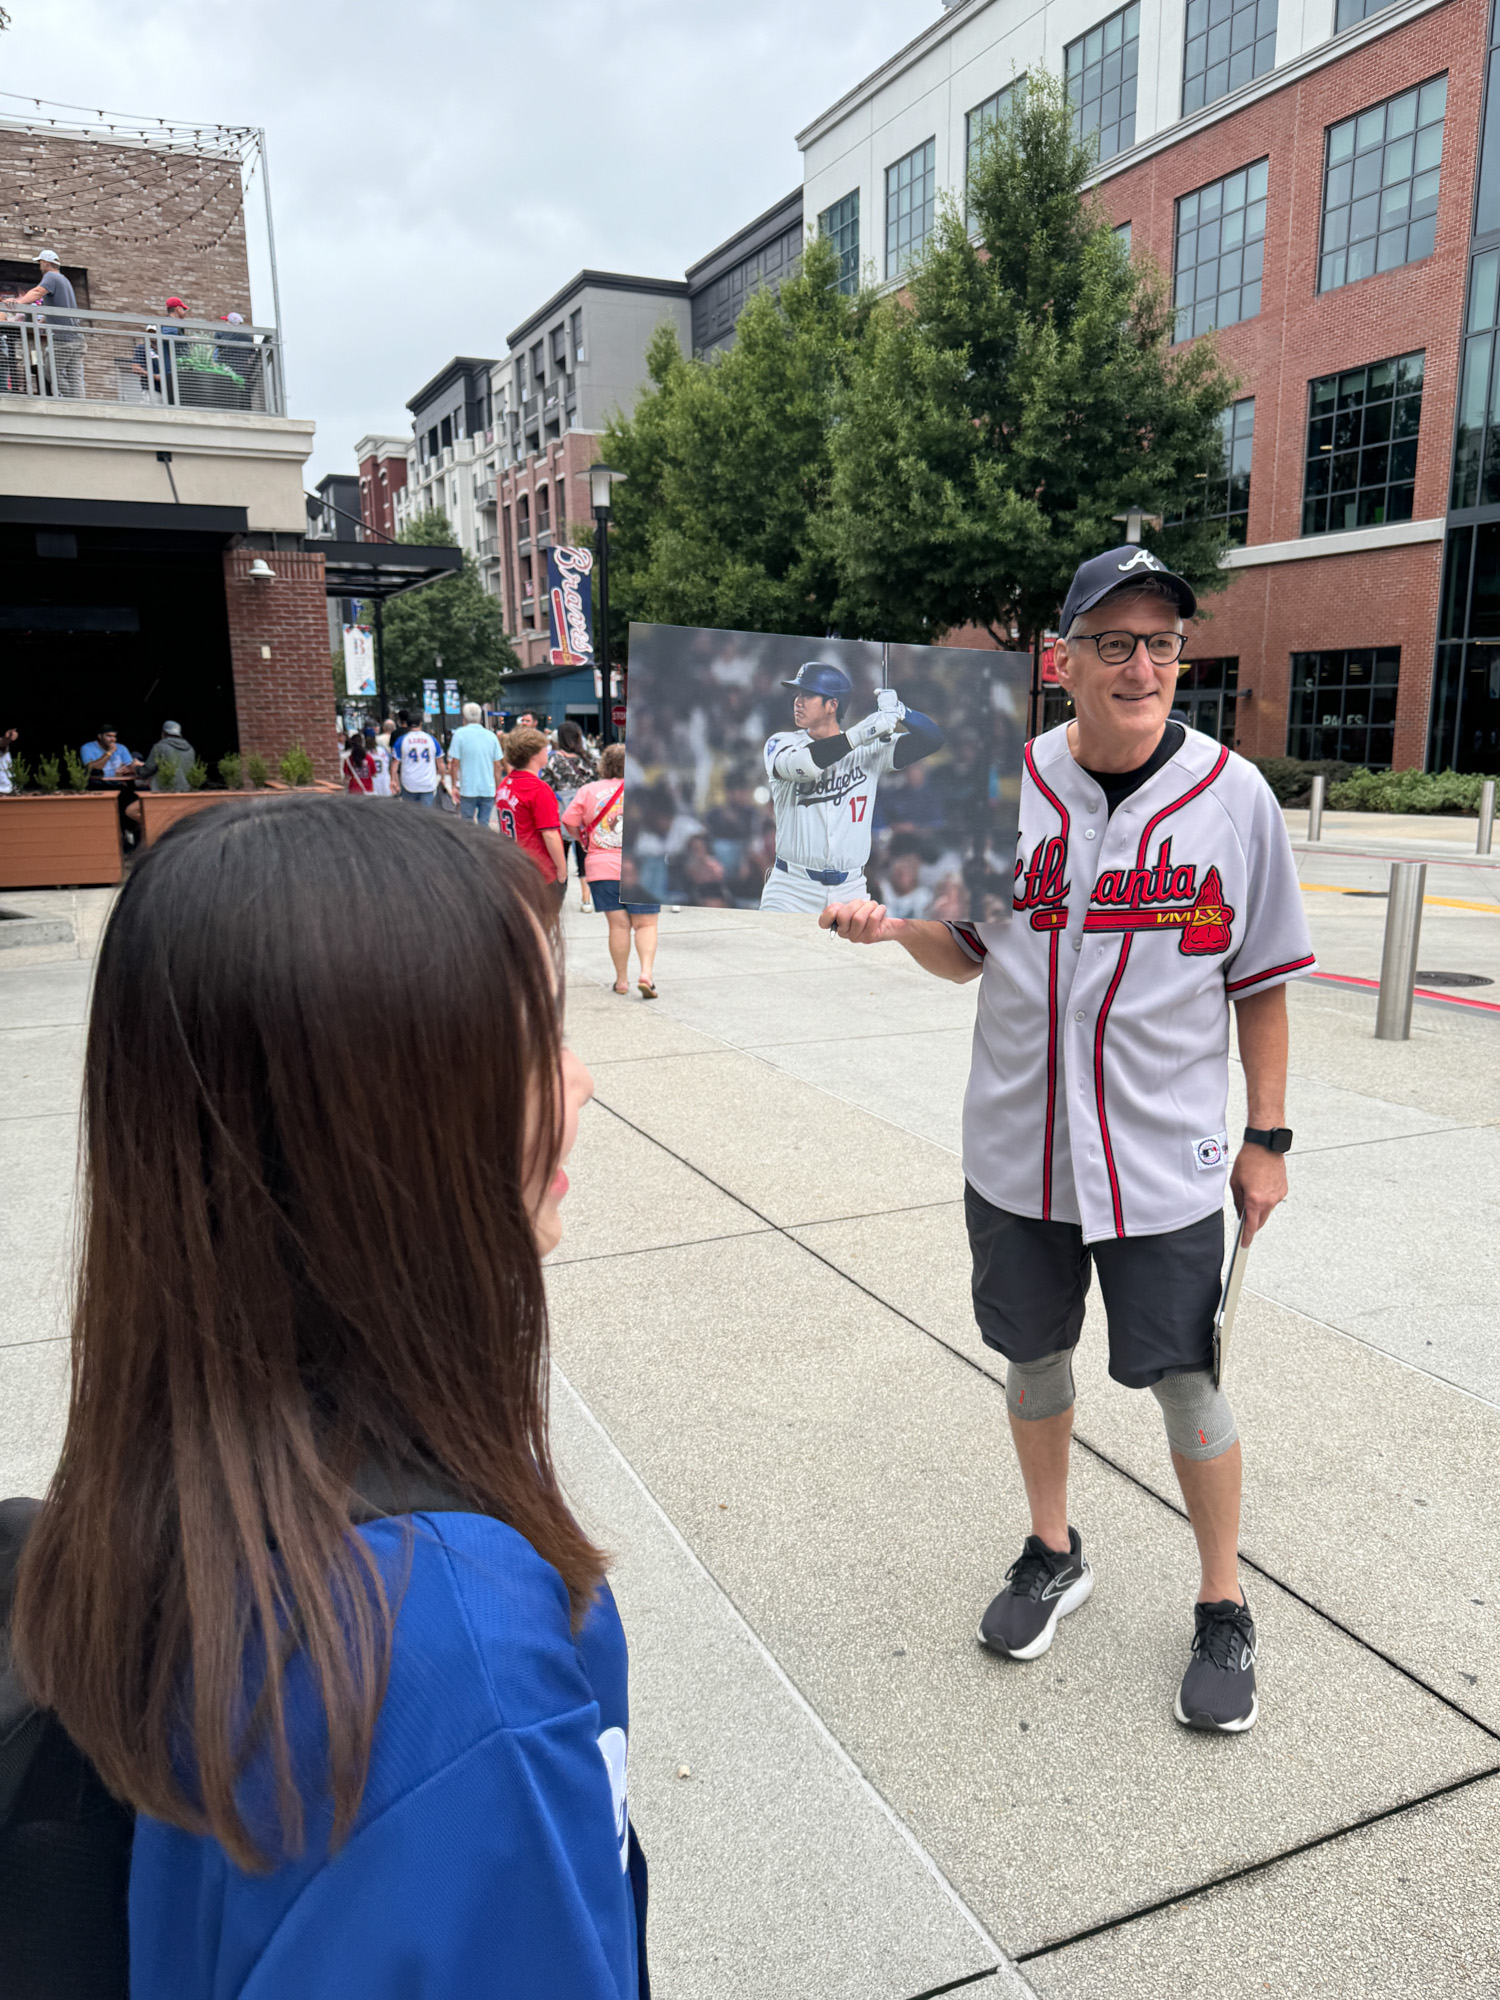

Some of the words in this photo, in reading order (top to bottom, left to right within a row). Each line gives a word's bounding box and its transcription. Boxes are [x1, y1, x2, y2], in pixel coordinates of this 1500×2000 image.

[1118, 550, 1159, 571] A
[553, 545, 593, 653] Braves
[611, 711, 626, 721] STO
[408, 747, 430, 763] 44
[795, 765, 867, 807] Dodgers
[849, 795, 867, 823] 17
